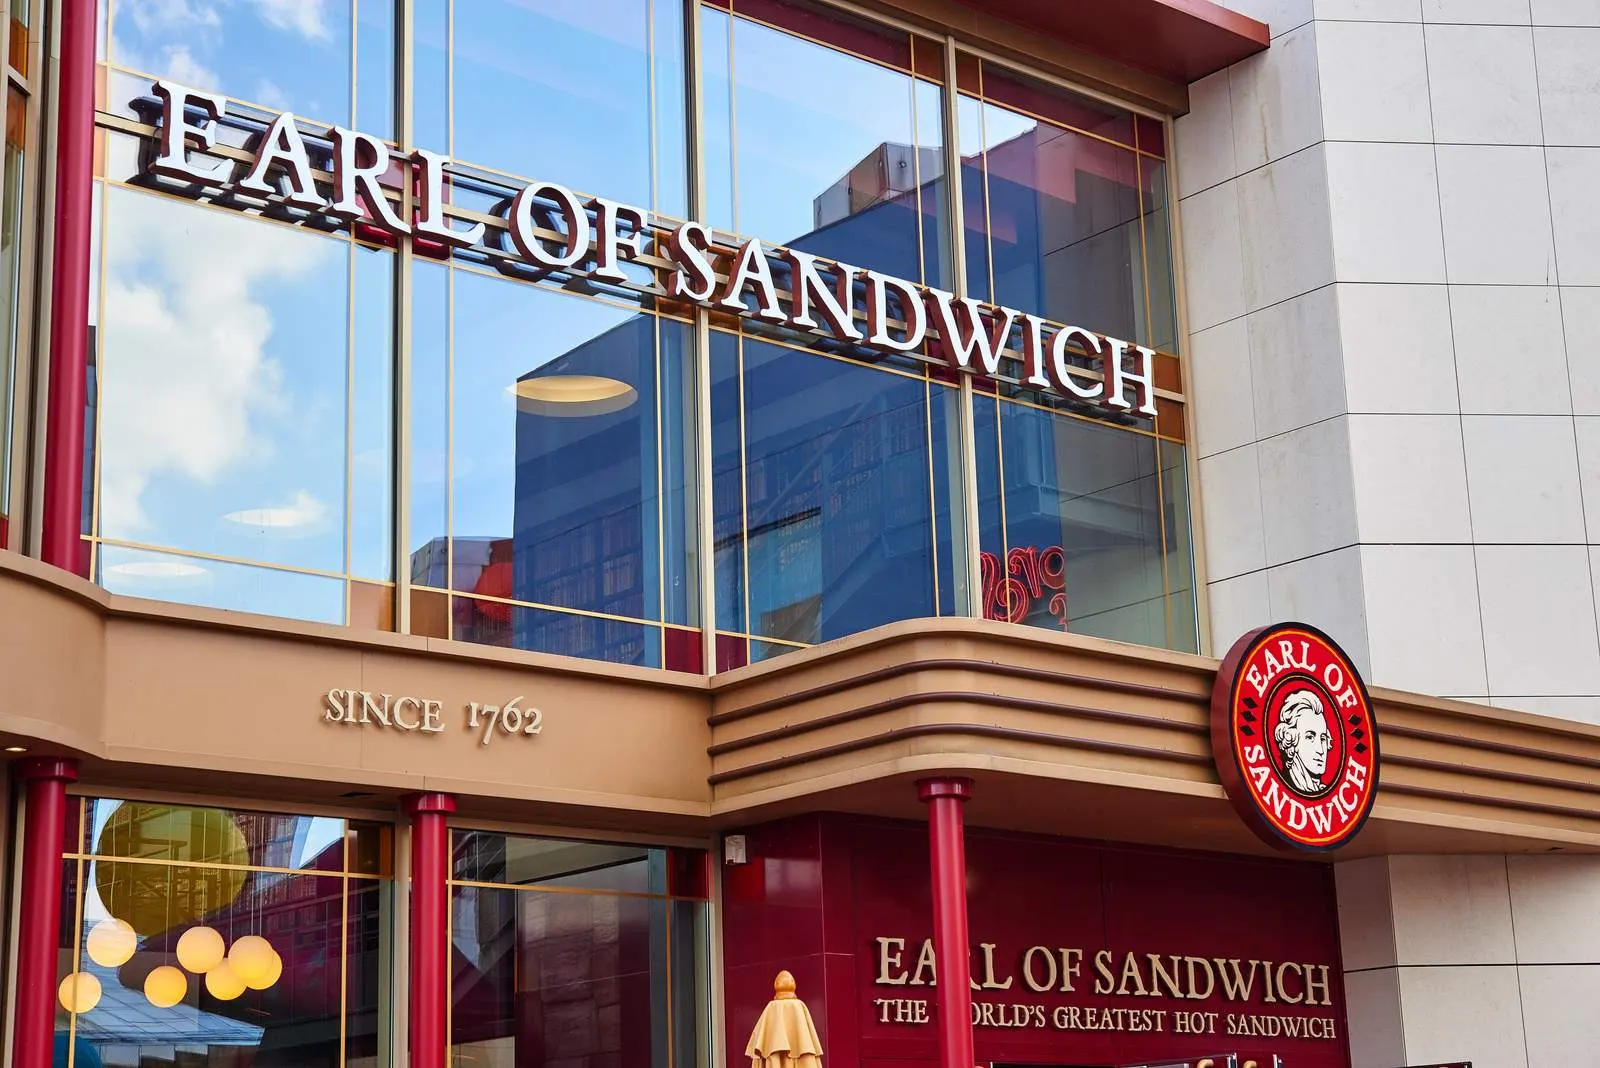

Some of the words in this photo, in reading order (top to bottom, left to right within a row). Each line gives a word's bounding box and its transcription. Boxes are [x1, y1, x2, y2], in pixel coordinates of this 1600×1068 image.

[153, 80, 486, 248] EARL
[510, 181, 650, 285] OF
[669, 221, 1159, 418] SANDWICH
[1245, 640, 1317, 698] EARL
[1324, 663, 1358, 709] OF
[325, 688, 446, 732] SINCE
[467, 695, 543, 746] 1762
[1244, 744, 1367, 835] SANDWICH
[875, 936, 1013, 991] EAL
[1023, 946, 1083, 992] OF
[1095, 950, 1332, 1006] SANDWICH
[874, 998, 930, 1024] THE
[936, 1002, 1046, 1028] ORLD'S
[1053, 1006, 1166, 1031] GREATEST
[1174, 1011, 1219, 1034] HOT
[1227, 1013, 1336, 1039] SANDWICH
